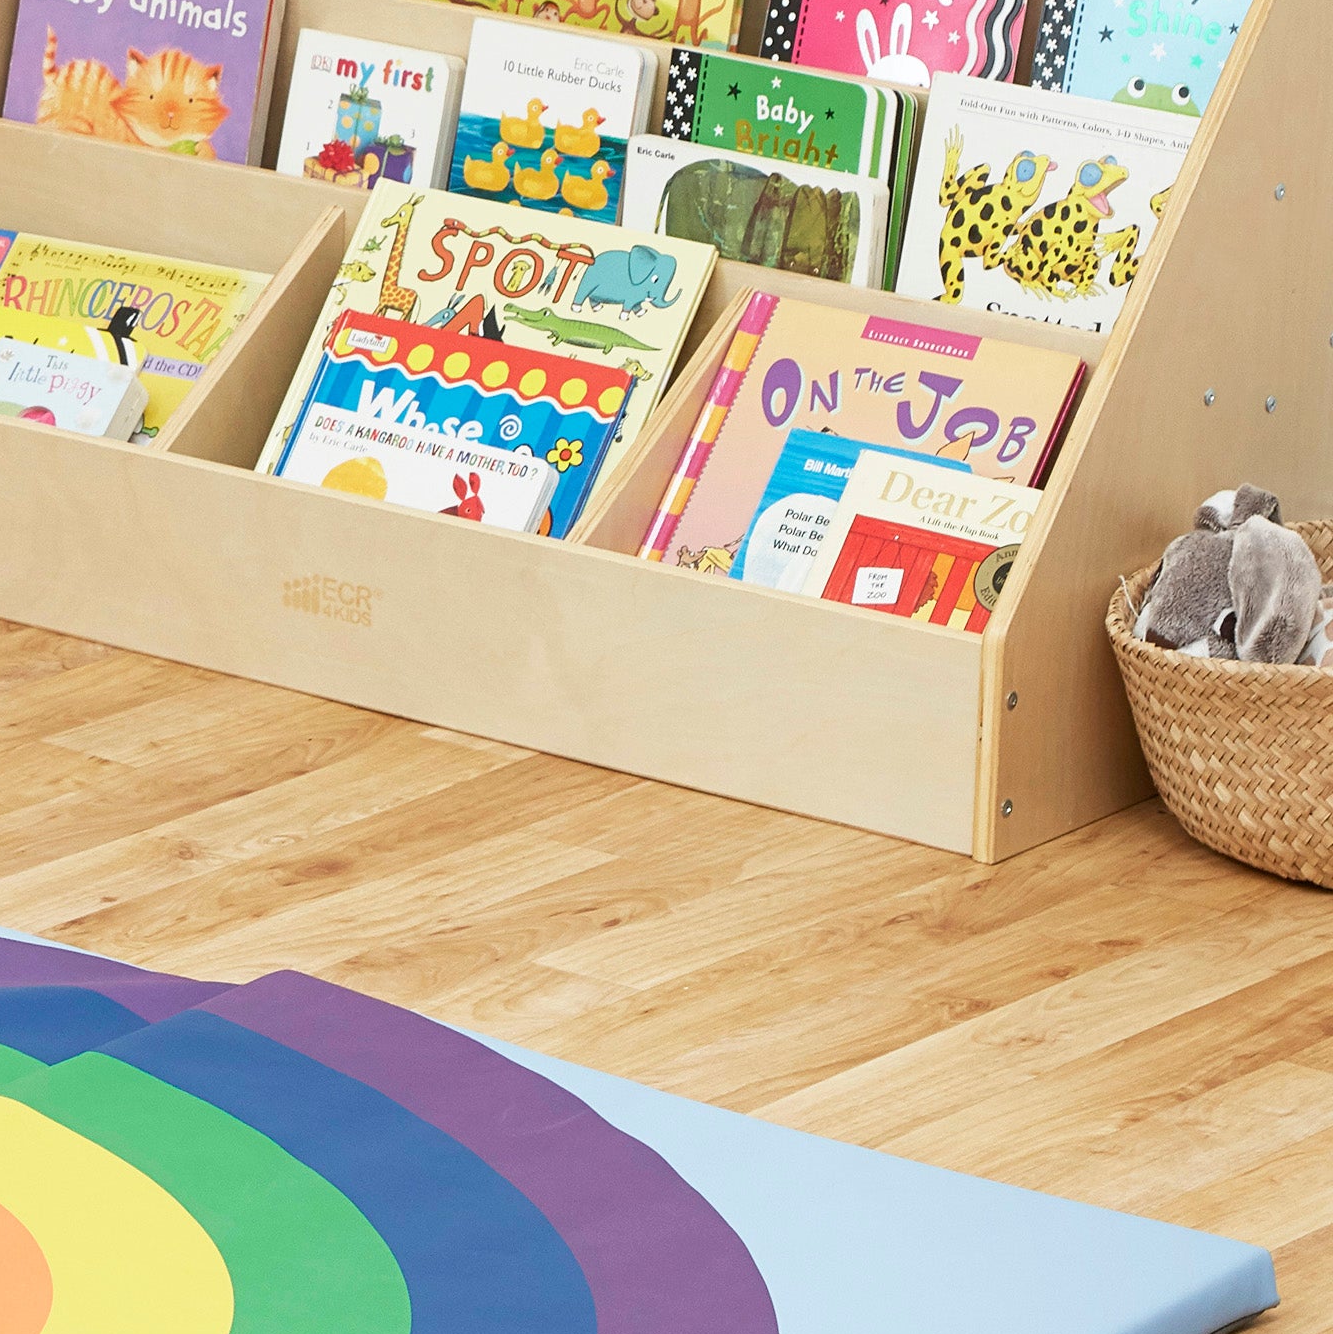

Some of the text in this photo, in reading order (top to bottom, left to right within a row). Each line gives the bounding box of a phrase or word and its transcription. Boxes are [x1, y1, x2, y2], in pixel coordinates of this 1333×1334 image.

[336, 58, 434, 92] my first
[503, 59, 622, 93] 10 Little Rubber Ducks
[574, 57, 625, 78] Eric Carle
[756, 94, 814, 135] Baby
[999, 106, 1016, 117] Fun
[1019, 111, 1039, 121] with
[637, 146, 675, 161] Eric Carle
[418, 227, 595, 303] SPOT
[157, 359, 175, 375] the
[178, 363, 202, 379] CD!
[48, 374, 102, 406] piggy
[761, 357, 1037, 464] ON THE JOB
[315, 416, 345, 432] DOES
[346, 424, 355, 436] A
[355, 426, 414, 451] KANGAROO
[415, 440, 446, 458] HAVE
[445, 448, 454, 461] A
[456, 450, 506, 475] MOTHER,
[803, 458, 824, 473] Bill
[877, 470, 977, 519] Dear
[785, 508, 814, 525] Polar
[778, 524, 807, 541] Polar
[977, 528, 999, 541] Book
[773, 539, 802, 555] What
[868, 573, 888, 581] FROM
